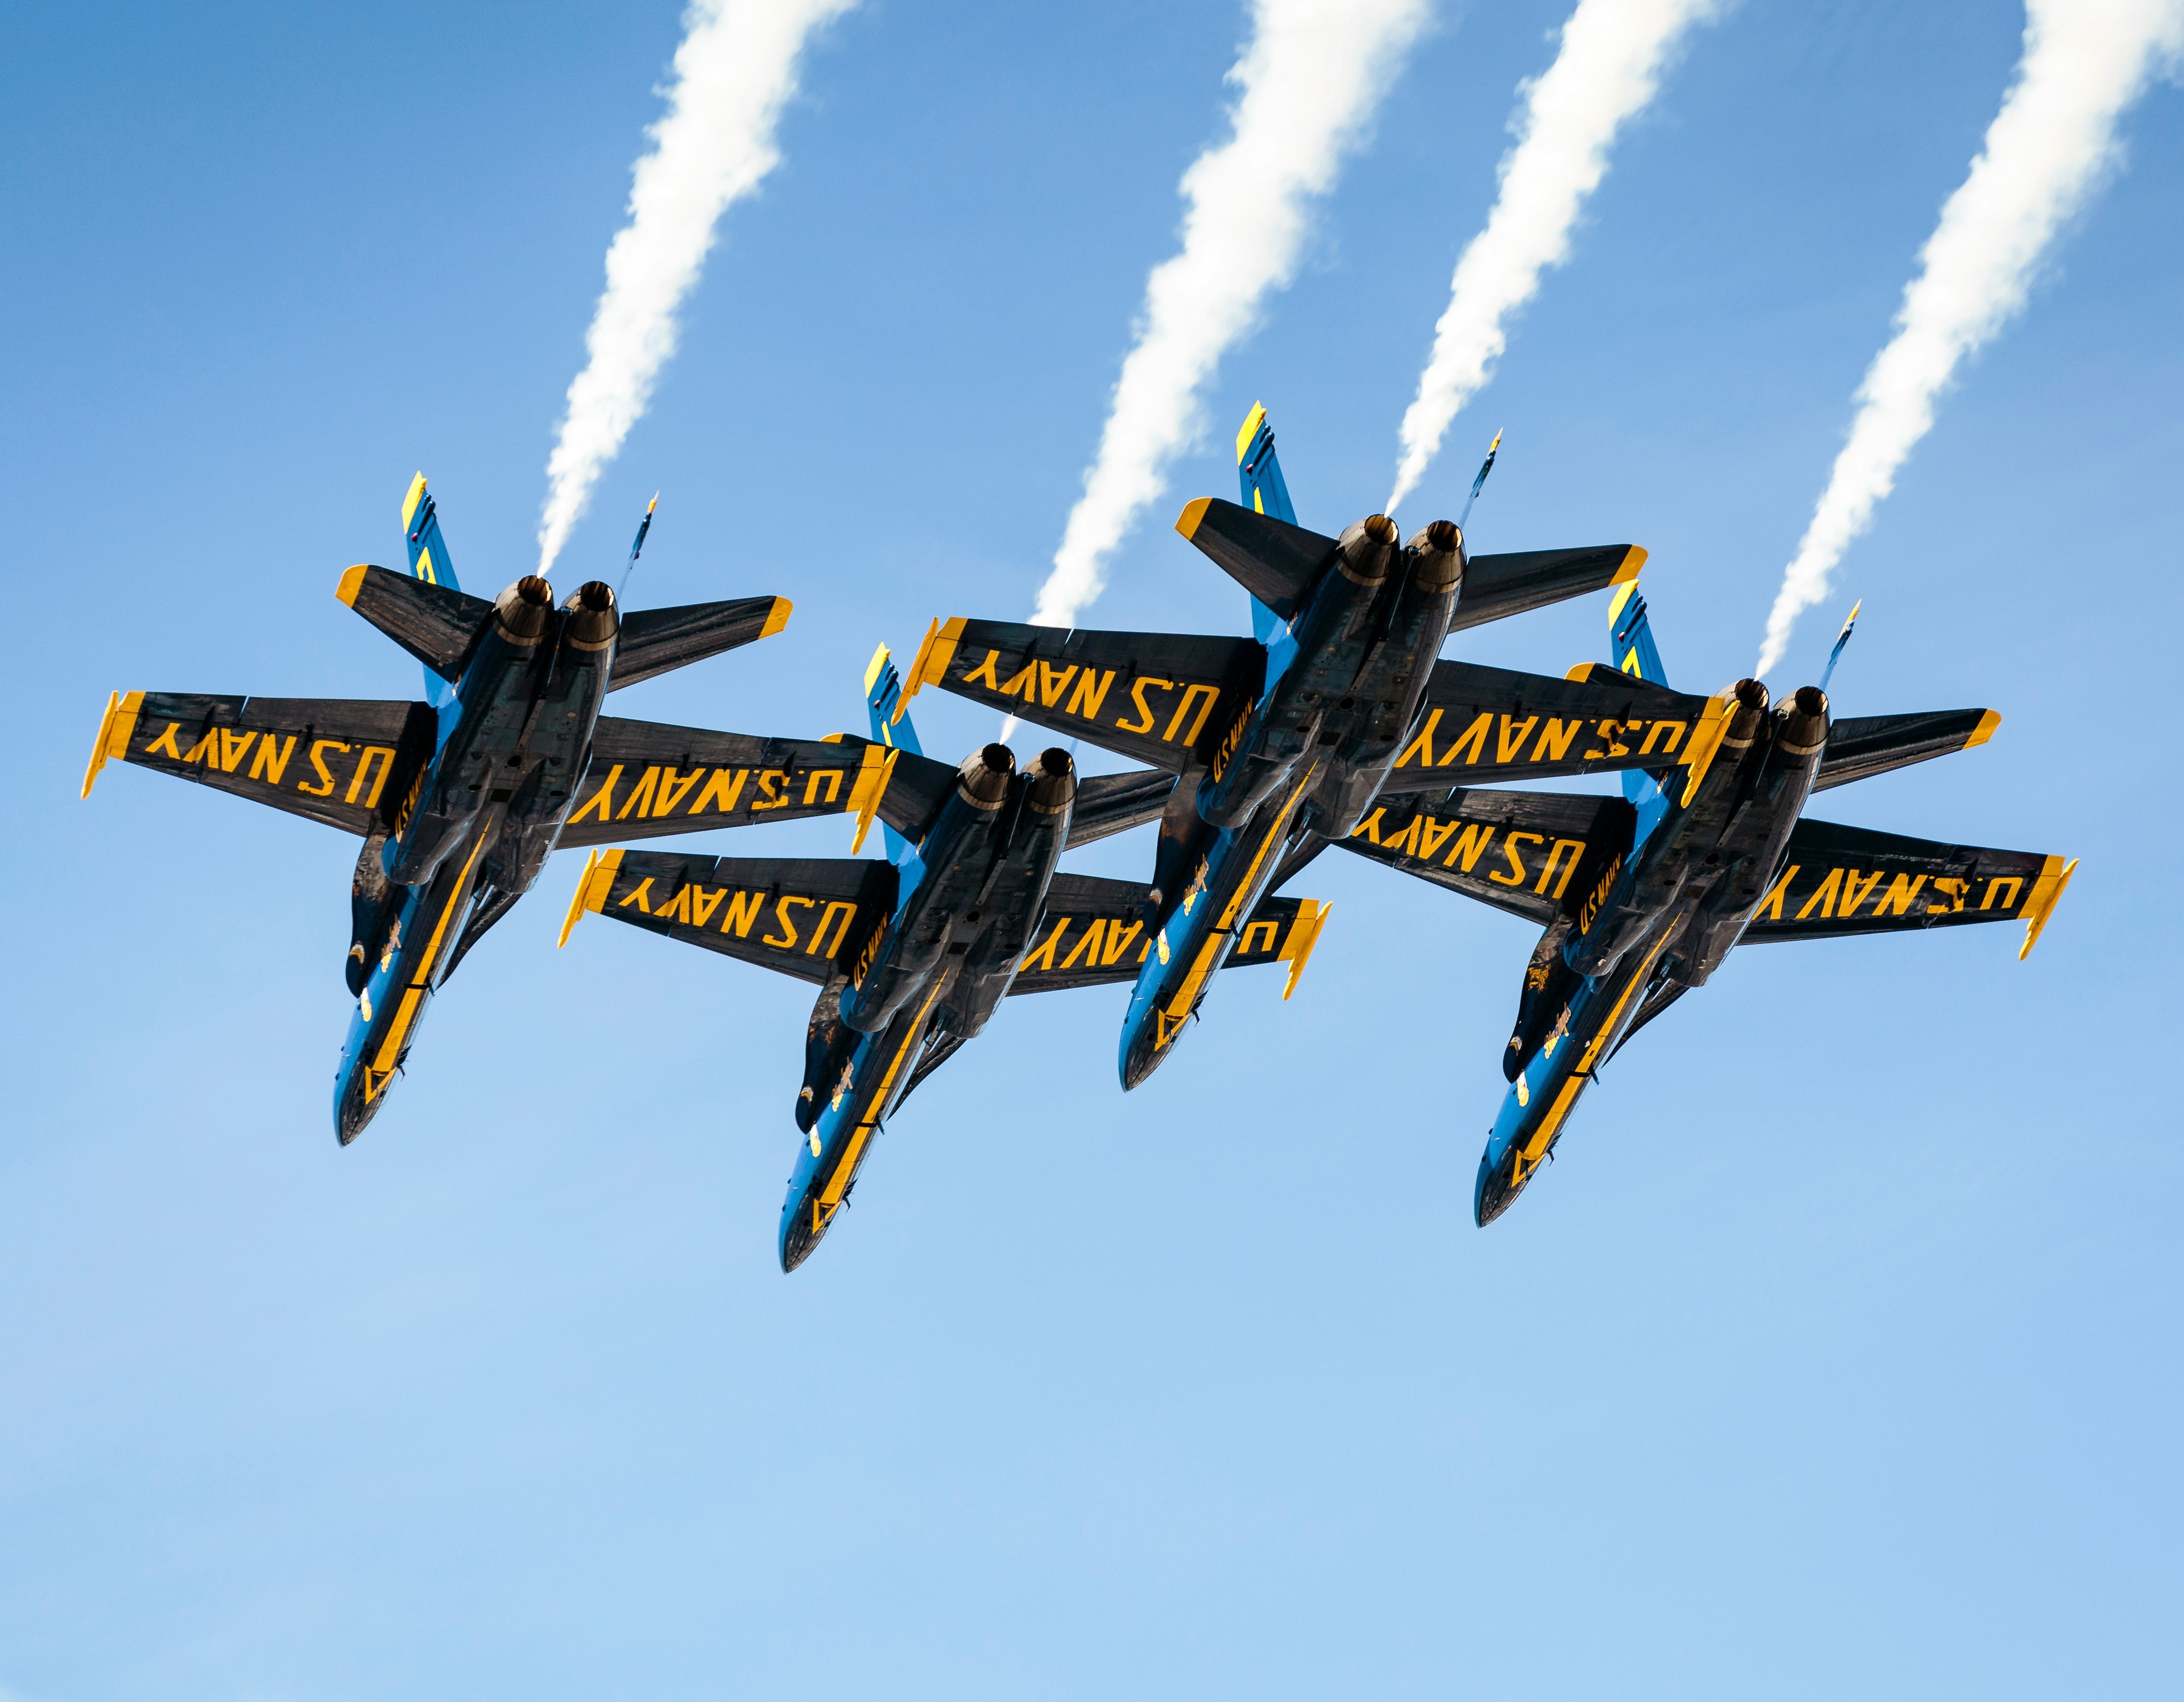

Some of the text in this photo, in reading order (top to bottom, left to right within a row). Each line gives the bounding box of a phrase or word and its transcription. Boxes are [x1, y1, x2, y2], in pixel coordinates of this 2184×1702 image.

[962, 650, 1116, 720] NAVY
[144, 722, 297, 785] NAVY
[1394, 709, 1583, 768] NAVY
[566, 764, 750, 823] NAVY
[1351, 807, 1496, 873] NAVY
[619, 877, 766, 938] NAVY
[1752, 865, 1929, 920] NAVY
[1019, 917, 1152, 972] AVY
